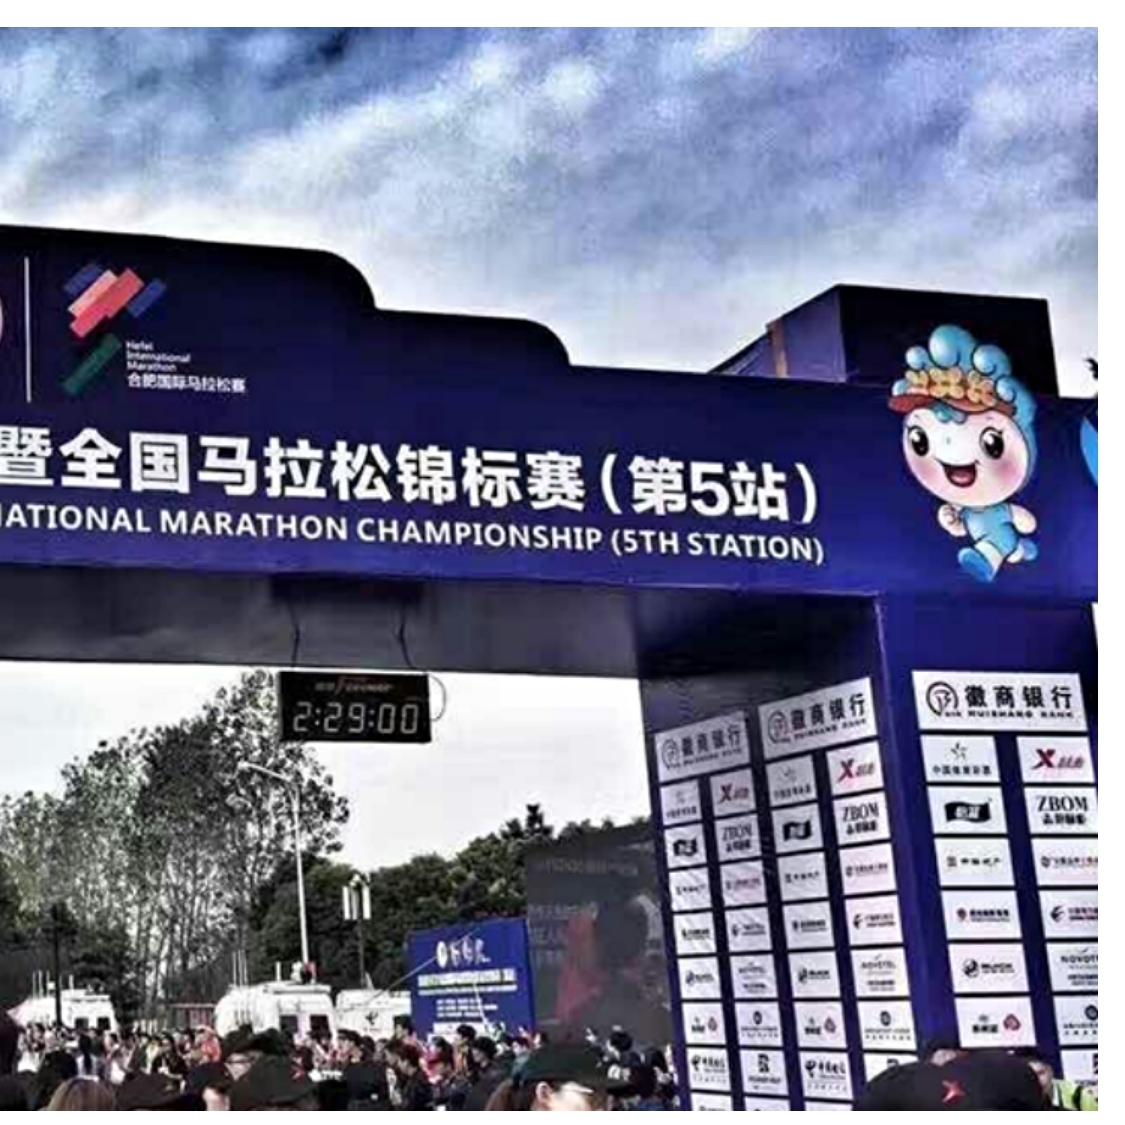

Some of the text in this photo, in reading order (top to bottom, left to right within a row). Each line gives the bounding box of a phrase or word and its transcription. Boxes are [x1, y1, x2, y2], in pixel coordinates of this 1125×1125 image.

[126, 351, 191, 363] International
[126, 361, 177, 372] Marathon
[127, 372, 246, 394] 合肥国际马拉松赛
[160, 509, 348, 541] MARATHON
[356, 517, 602, 550] CHAMPIONSHIP
[611, 528, 679, 556] (5TH
[687, 532, 824, 565] STATION)
[964, 684, 1073, 709] 徽商银行
[293, 701, 418, 734] 2:29:00
[1037, 796, 1089, 812] ZBOM
